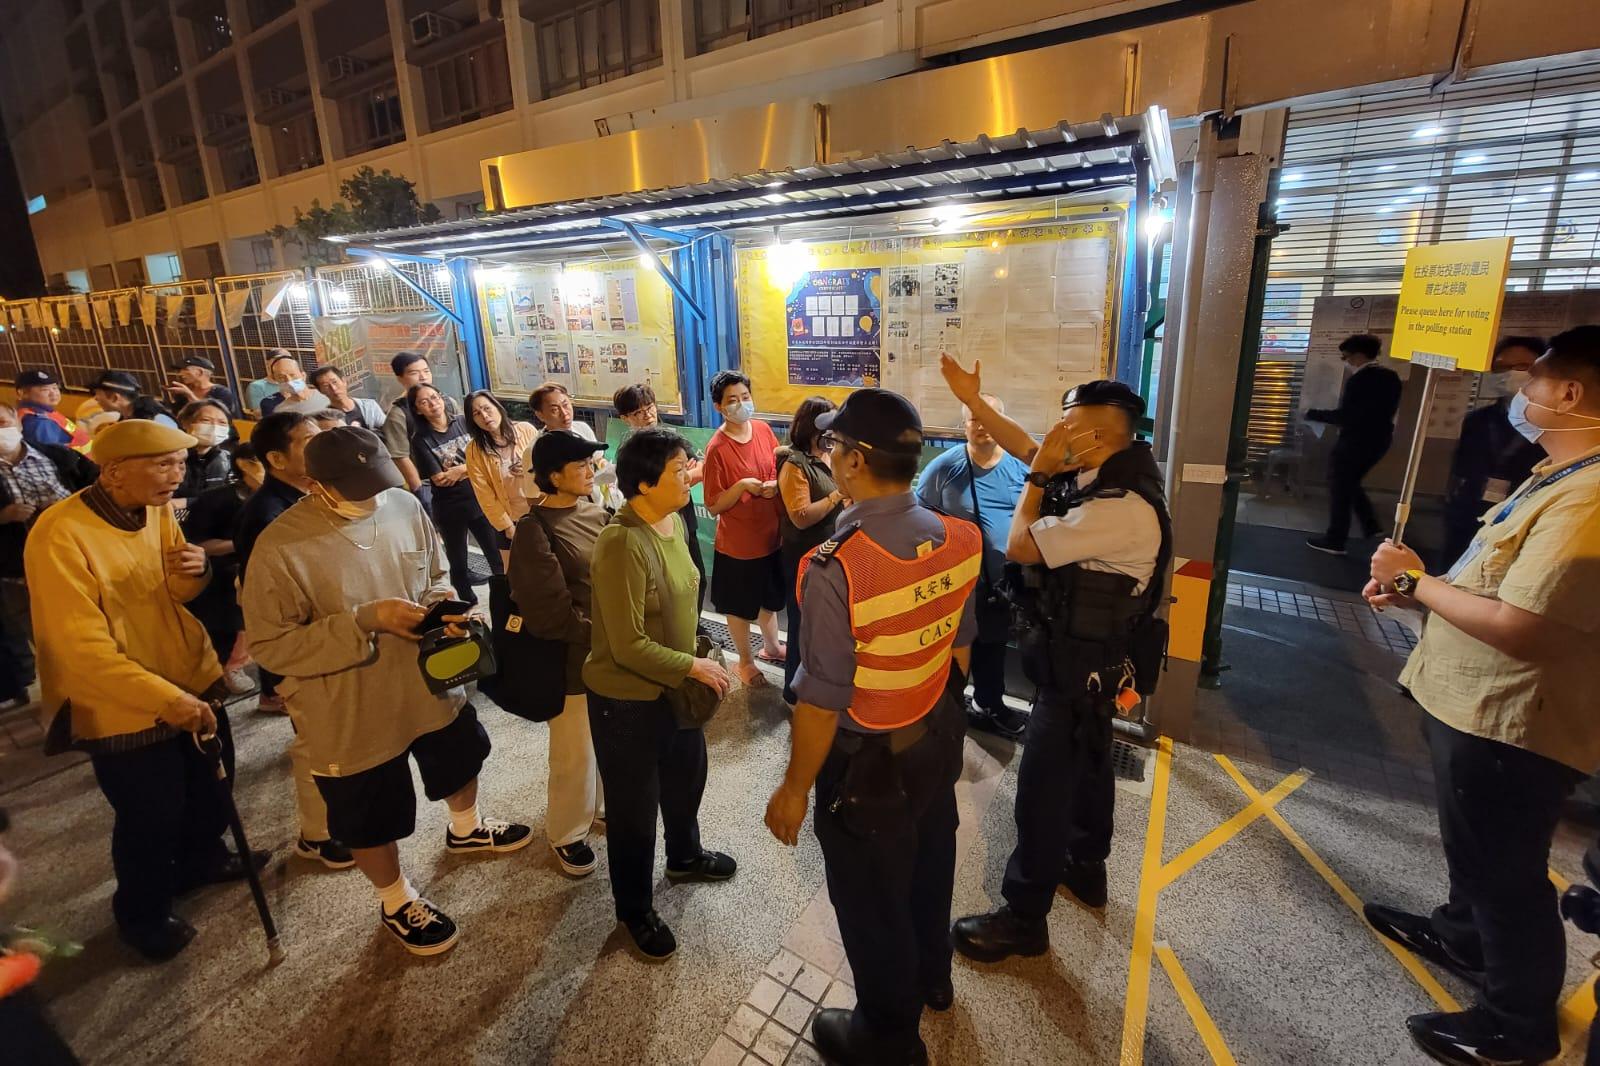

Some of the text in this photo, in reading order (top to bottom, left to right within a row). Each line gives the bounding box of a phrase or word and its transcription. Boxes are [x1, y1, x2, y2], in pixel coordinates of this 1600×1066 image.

[1401, 305, 1490, 321] Please queue here for voting
[1408, 321, 1473, 337] in the polling station
[914, 573, 954, 602] 民安隊
[919, 617, 953, 647] CAS
